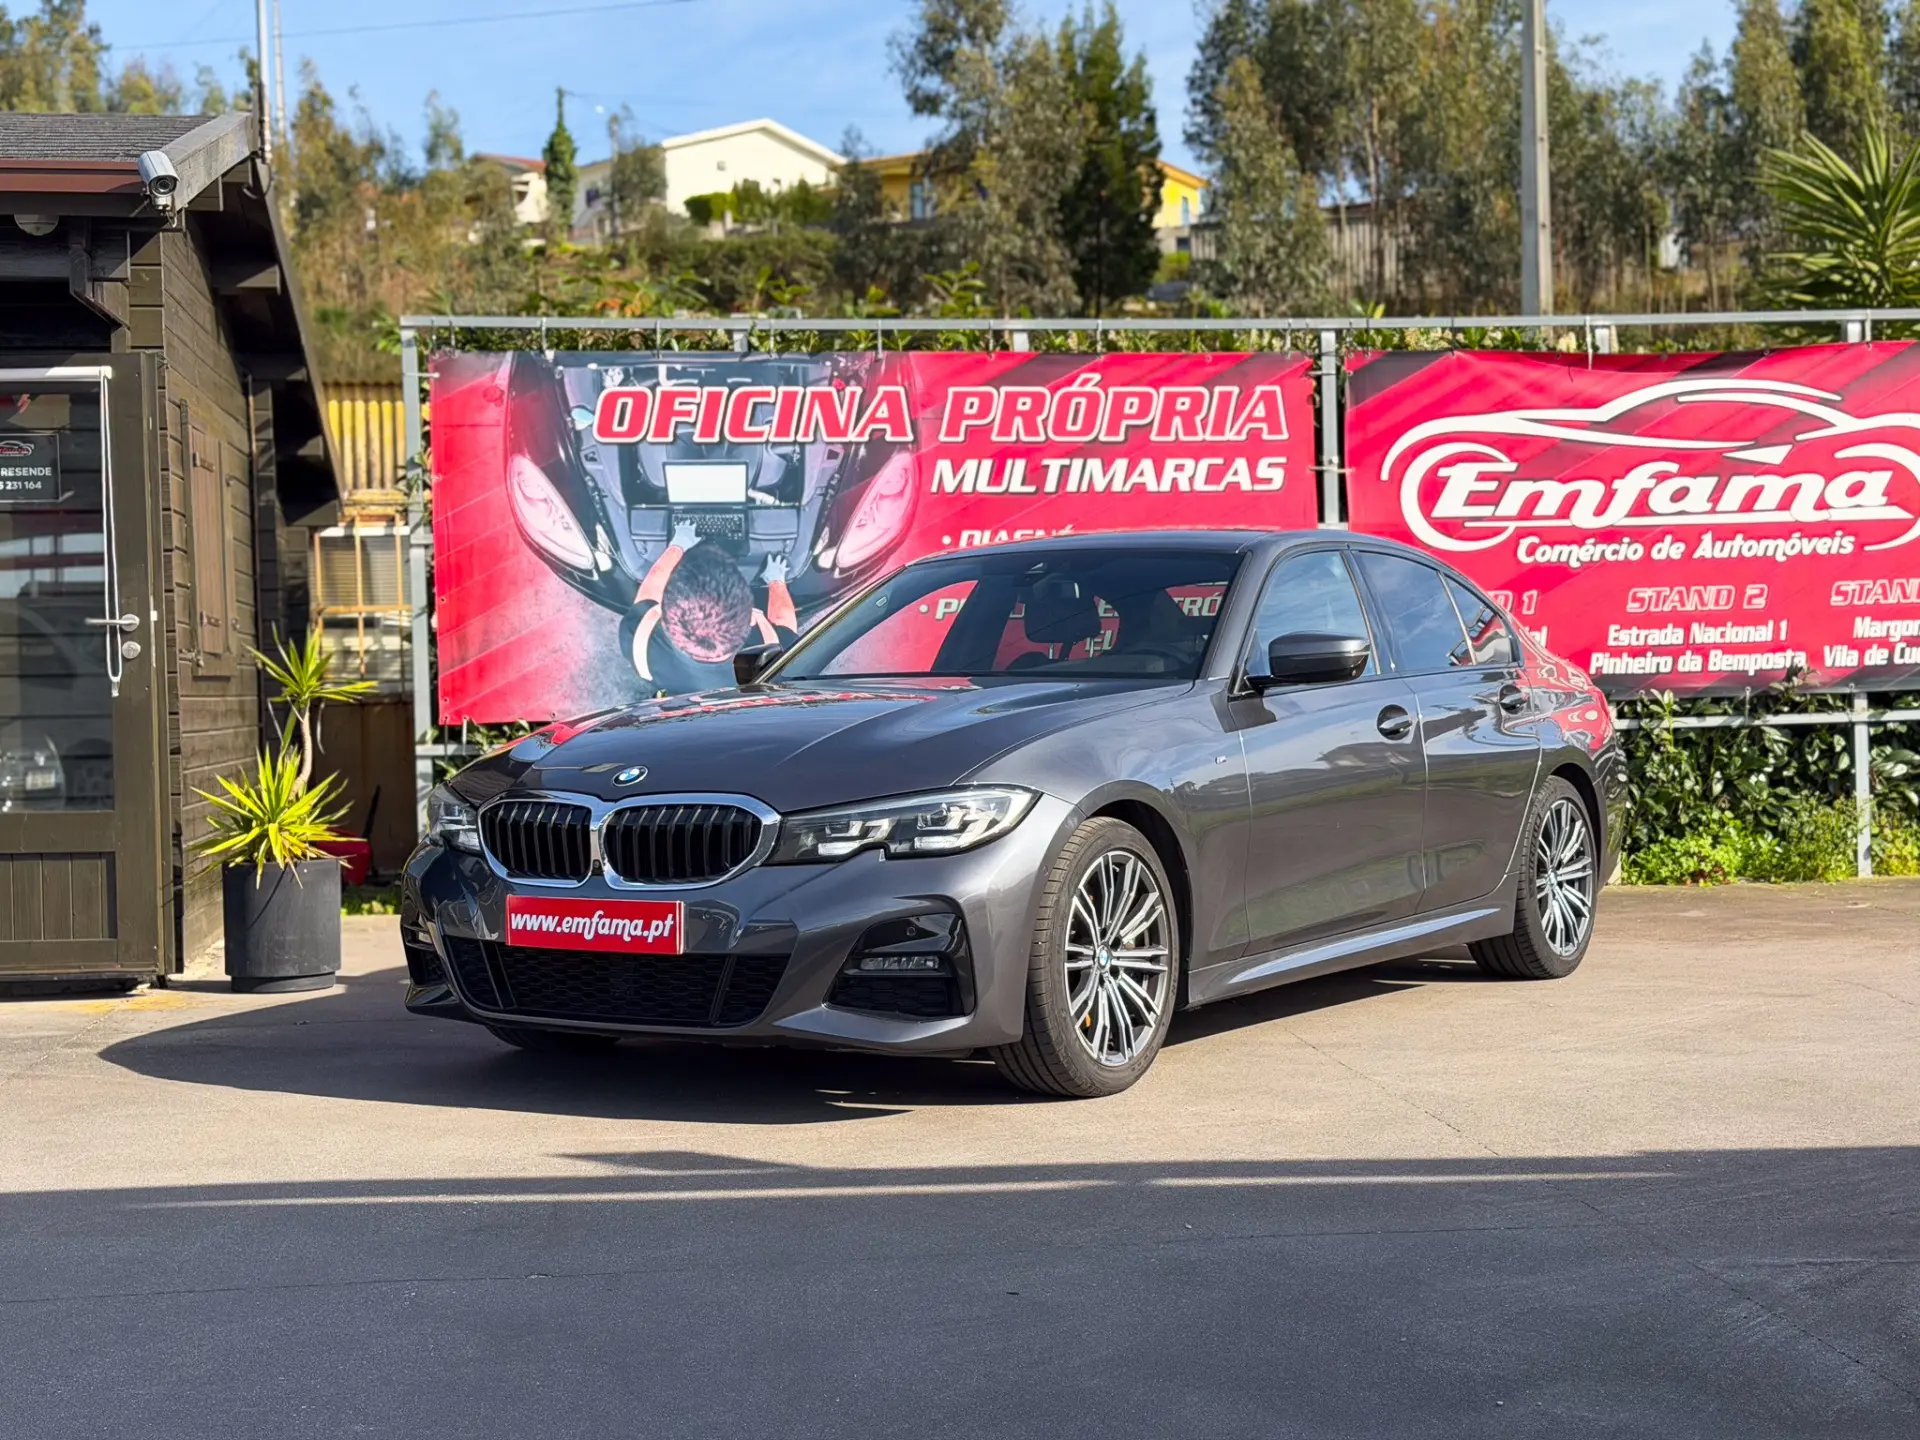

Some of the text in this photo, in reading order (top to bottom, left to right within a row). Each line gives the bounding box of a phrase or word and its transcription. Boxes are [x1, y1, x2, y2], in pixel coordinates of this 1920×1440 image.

[593, 373, 1289, 443] OFICINA PRÓPRIA
[0, 467, 52, 477] RESENDE
[5, 481, 22, 490] 231
[24, 481, 42, 490] 164
[930, 456, 1287, 493] MULTIMARCAS
[1430, 460, 1894, 529] Emfama
[1516, 528, 1855, 567] Comércio de Automóveis
[1522, 590, 1538, 615] 1
[1626, 584, 1768, 612] STAND 2
[1830, 578, 1920, 606] STAN
[1608, 619, 1788, 646] Estrada Nacional 1
[1590, 648, 1807, 675] Pinheiro da Bemposta
[1824, 645, 1859, 667] Vila
[1864, 643, 1889, 665] de
[511, 910, 674, 943] www.emfama.pt
